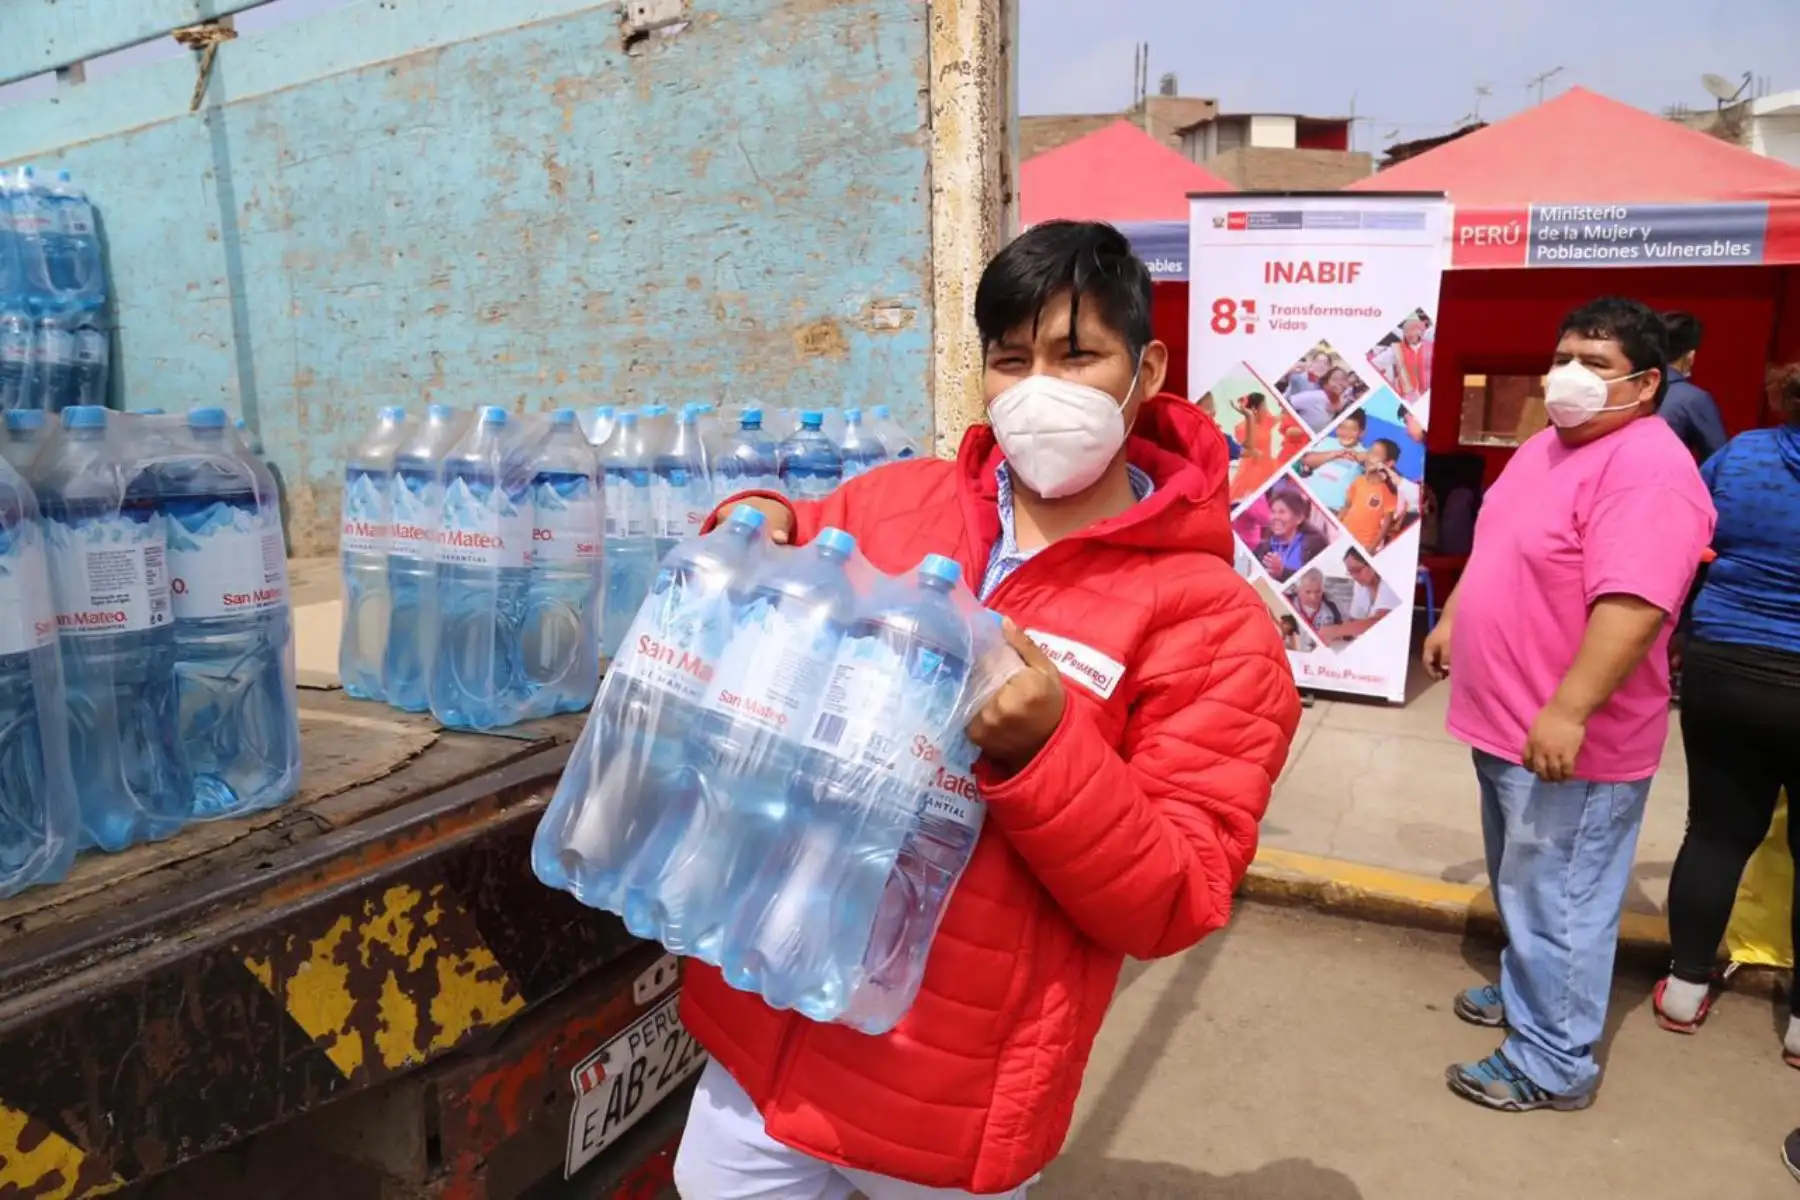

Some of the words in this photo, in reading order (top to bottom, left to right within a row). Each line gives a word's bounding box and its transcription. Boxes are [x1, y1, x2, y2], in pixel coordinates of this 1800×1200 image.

[1539, 205, 1628, 221] Ministerio
[1460, 219, 1520, 246] PERÚ
[1538, 225, 1560, 240] de
[1563, 224, 1579, 240] la
[1583, 223, 1637, 242] Mujer
[1640, 226, 1652, 241] y
[1536, 243, 1640, 260] Poblaciones
[1643, 239, 1752, 258] Vulnerables
[1264, 261, 1363, 284] INABIF
[1270, 303, 1382, 318] Transformando
[1269, 319, 1308, 331] Vidas
[638, 635, 674, 664] San
[719, 689, 741, 708] San
